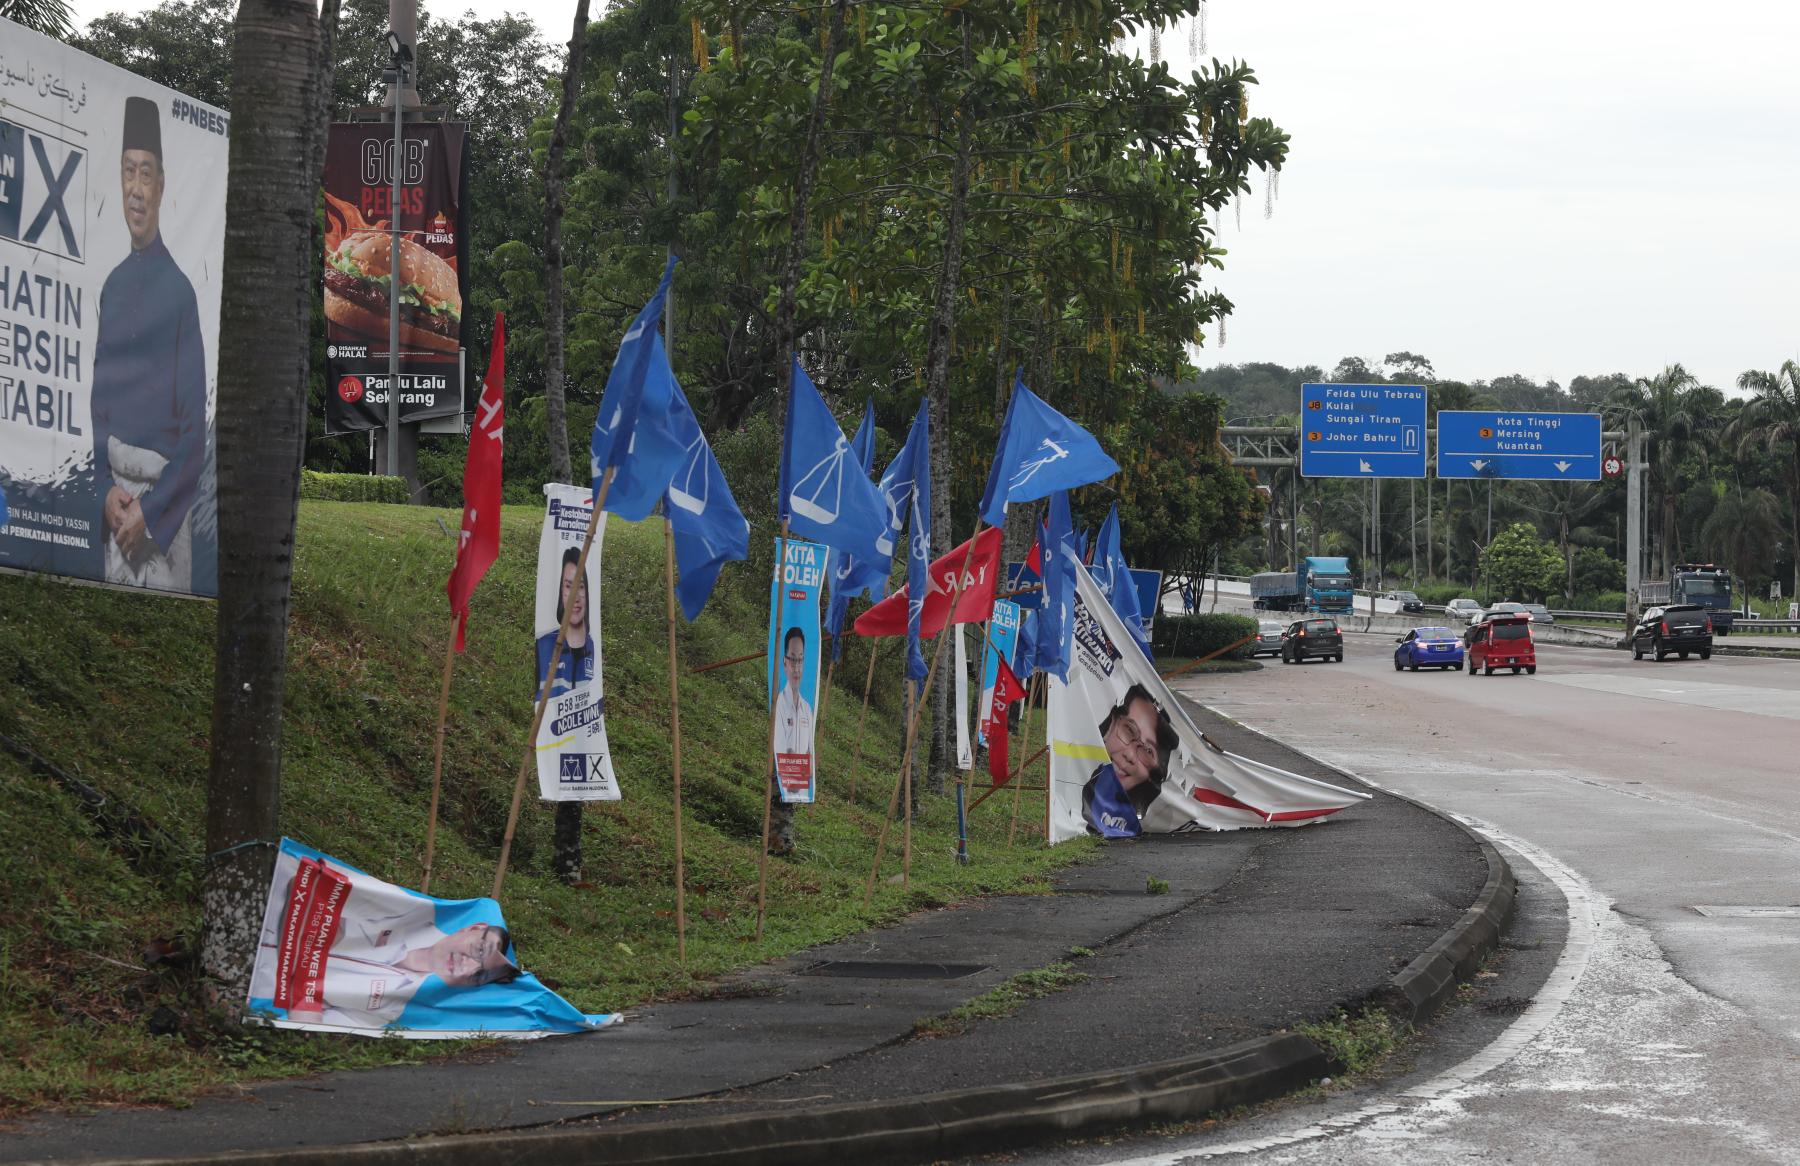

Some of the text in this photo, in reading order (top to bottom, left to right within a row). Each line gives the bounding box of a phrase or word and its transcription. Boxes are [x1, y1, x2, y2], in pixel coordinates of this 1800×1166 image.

[0, 154, 15, 179] N
[22, 133, 84, 259] X
[426, 233, 454, 245] PEDAS
[414, 376, 446, 389] Lalu
[1326, 389, 1422, 399] Felda Ulu Tebrau
[1308, 400, 1321, 410] J8
[1326, 401, 1354, 410] Kulai
[1326, 414, 1401, 425] Sungai Tiram
[1497, 417, 1561, 429] Kota Tinggi
[1311, 432, 1318, 441] 3
[1326, 432, 1397, 442] Johor Bahru
[1482, 429, 1489, 437] 3
[1497, 429, 1540, 440] Mersing
[1497, 441, 1542, 450] Kuantan
[22, 509, 39, 523] HAJI
[41, 513, 63, 527] MOHD
[65, 517, 90, 531] YASSIN
[10, 525, 52, 543] PERIKATAN
[53, 533, 90, 549] NASIONAL
[785, 544, 815, 566] KITA
[994, 601, 1013, 617] KITA
[279, 865, 314, 1000] UNDI X PAKATAN HARAPAN
[300, 902, 325, 969] P158 TEBRAU
[306, 877, 346, 1004] JIMMY PUAH WEE TSE
